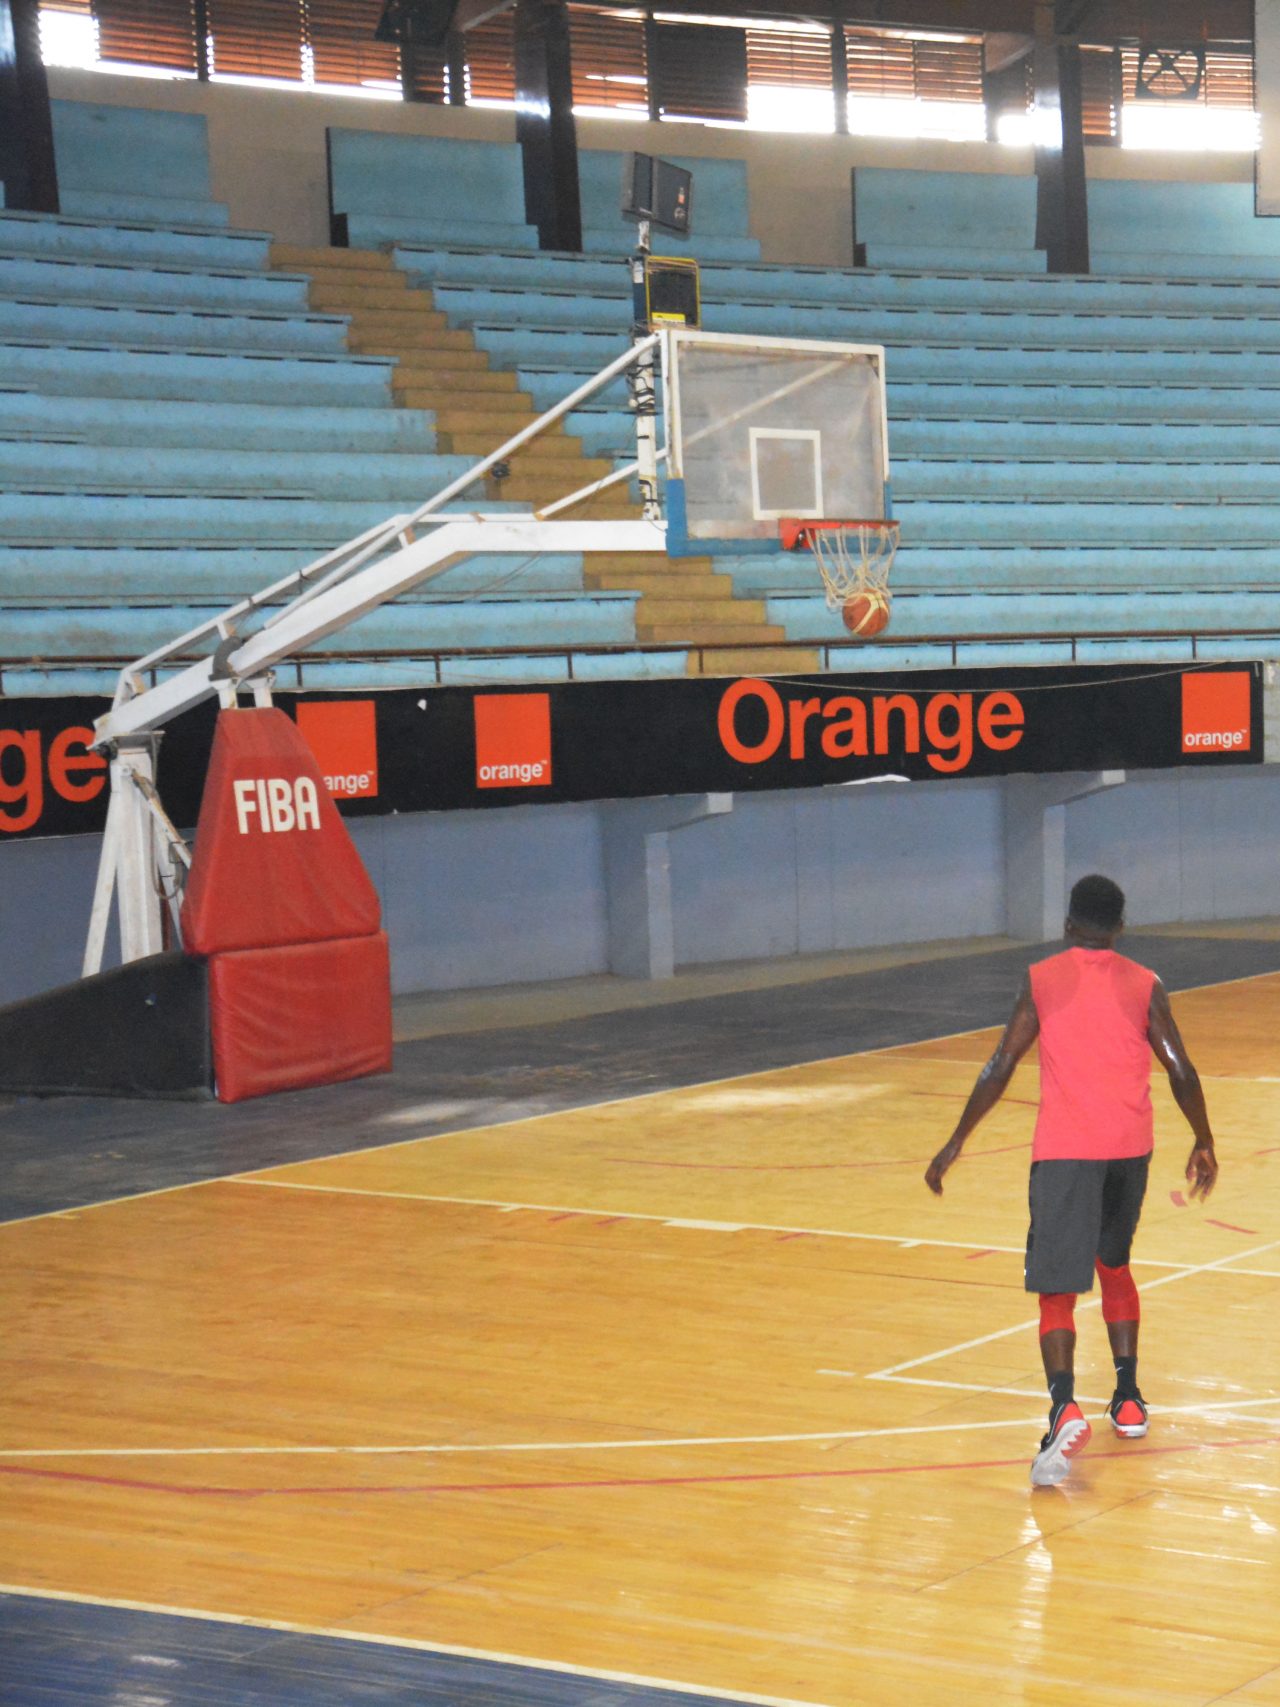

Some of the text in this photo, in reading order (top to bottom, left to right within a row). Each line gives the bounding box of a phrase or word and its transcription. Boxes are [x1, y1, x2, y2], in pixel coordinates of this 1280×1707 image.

[717, 677, 1025, 772] Orange
[1184, 730, 1243, 748] orange
[0, 725, 108, 832] ge
[323, 772, 370, 794] ange
[479, 762, 543, 782] orange
[233, 776, 321, 834] FIBA
